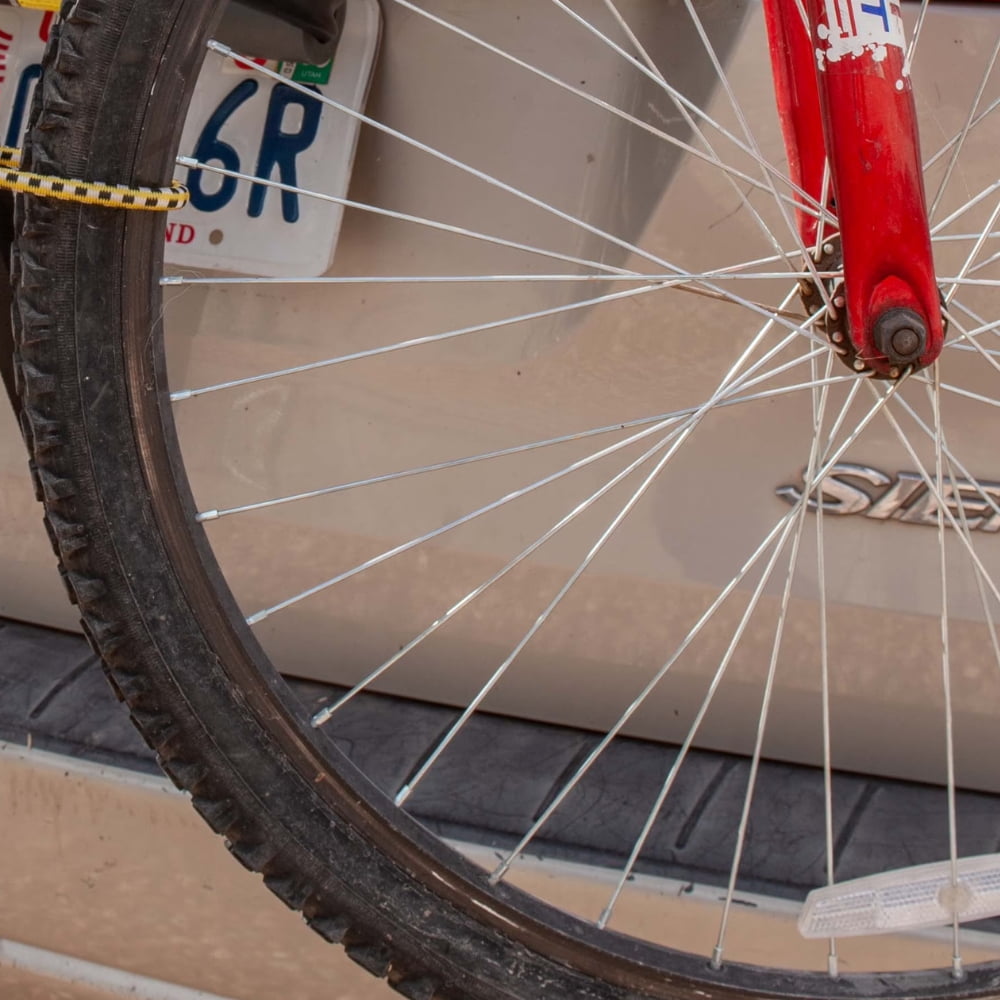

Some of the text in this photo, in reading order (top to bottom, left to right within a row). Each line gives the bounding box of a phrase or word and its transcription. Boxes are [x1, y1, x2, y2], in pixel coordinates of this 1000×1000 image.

[301, 70, 322, 79] UTAH
[164, 222, 196, 245] ND
[775, 462, 1000, 533] SIE
